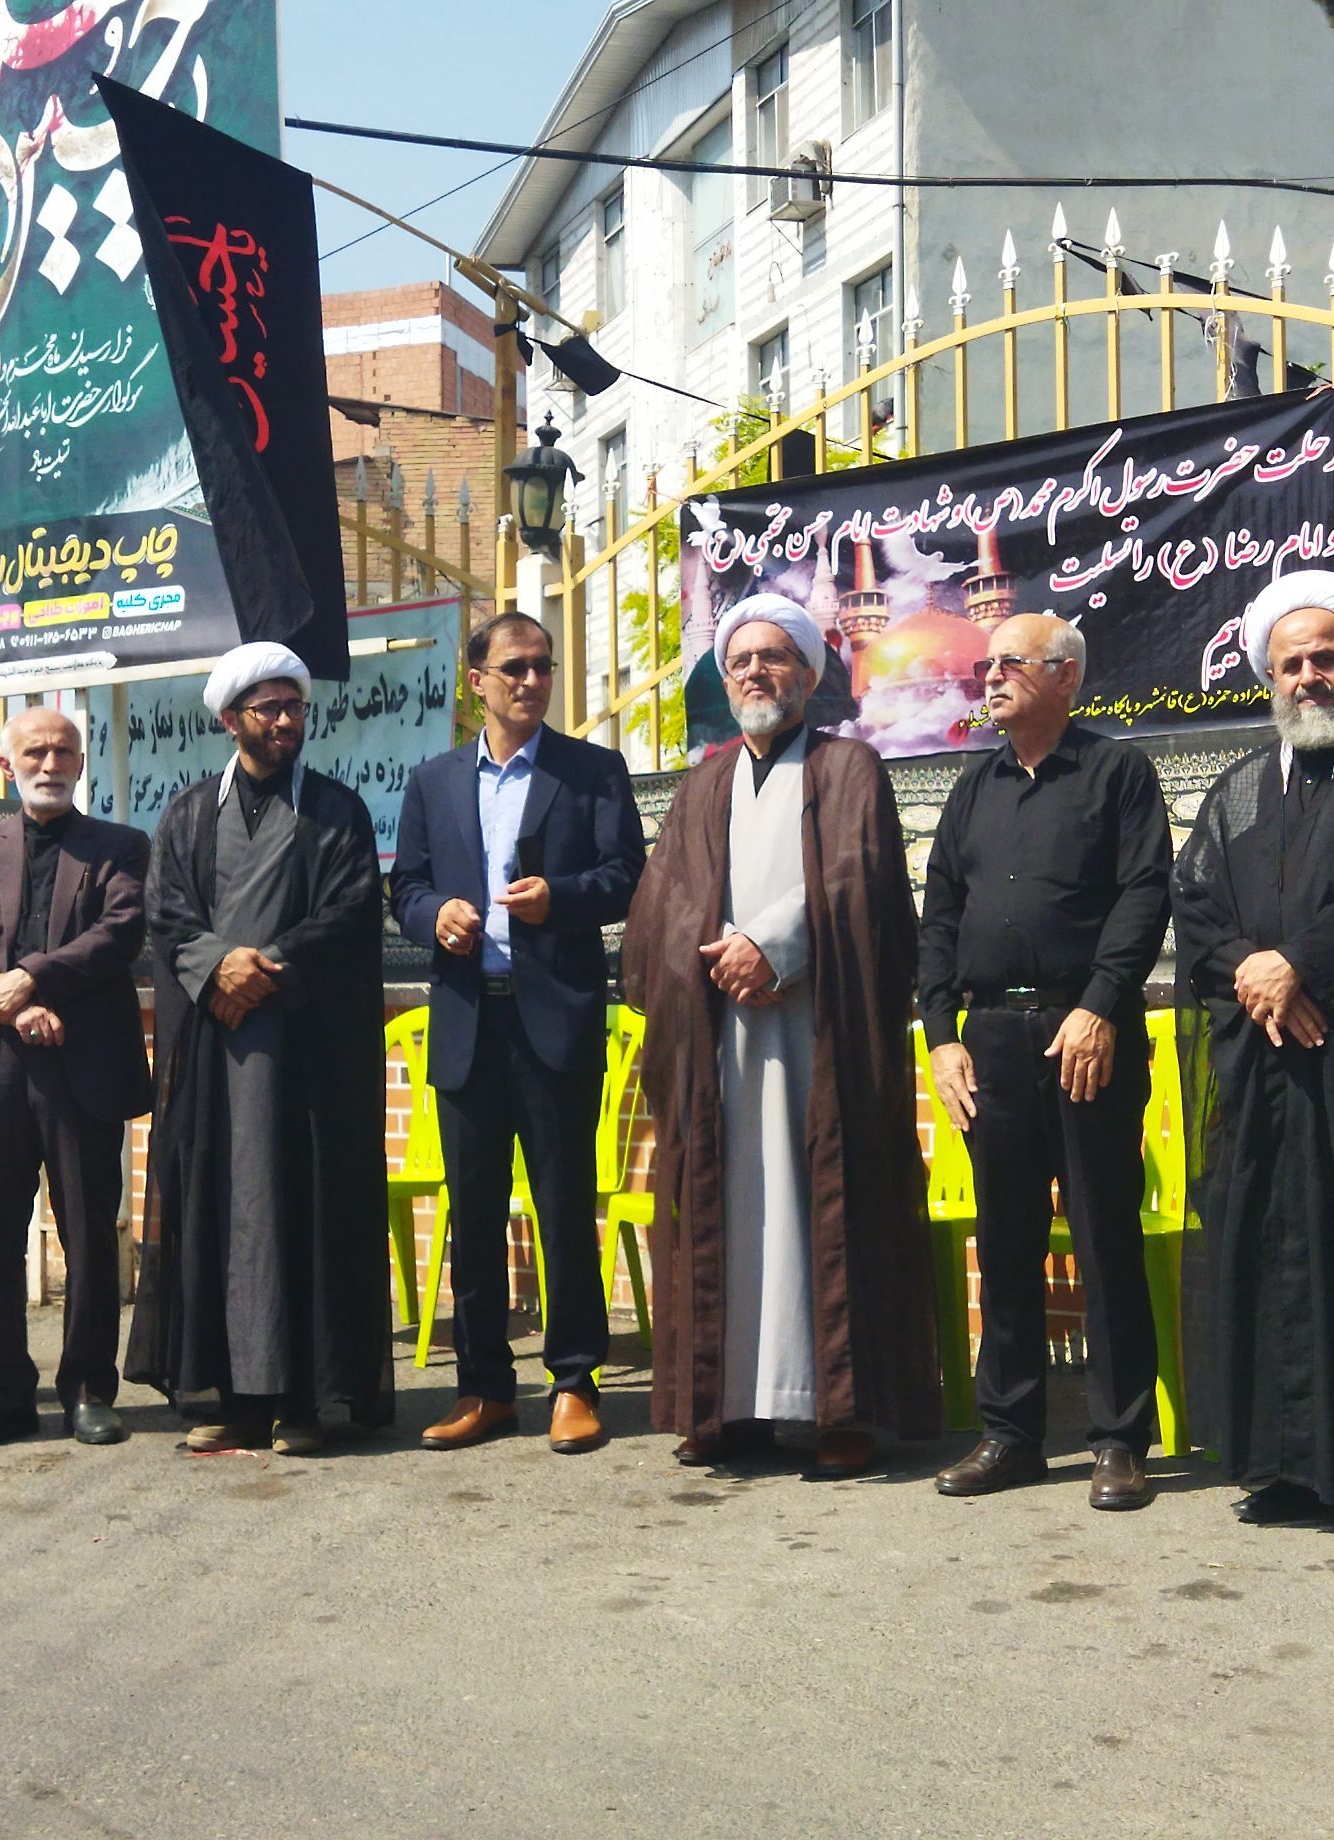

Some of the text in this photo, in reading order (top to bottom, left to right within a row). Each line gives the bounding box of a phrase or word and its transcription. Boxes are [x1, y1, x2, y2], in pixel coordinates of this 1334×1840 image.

[1048, 427, 1122, 546] اکرم
[1098, 458, 1168, 517] رسول
[1164, 435, 1260, 502] حضرت
[871, 484, 955, 540] شهادت
[1022, 477, 1057, 521] محمد
[1, 527, 112, 596] دیجیتال
[112, 523, 179, 583] چاپ
[742, 502, 793, 577] مجتبی
[786, 510, 833, 562] حسن
[831, 510, 872, 576] امام
[1050, 516, 1141, 609] تسلیت
[1157, 536, 1218, 590] (ع)
[1224, 528, 1275, 570] رضا
[1273, 520, 1323, 583] امام
[117, 592, 182, 613] مجری کلیه
[352, 672, 409, 726] جماعت
[414, 663, 447, 727] نماز
[1069, 696, 1109, 717] مقاوم
[1109, 694, 1134, 726] پایگاه
[1178, 691, 1207, 713] (ع)
[1207, 689, 1232, 709] حمزه
[129, 702, 146, 755] مغر
[149, 697, 174, 755] نماز
[129, 771, 165, 813] برگزا
